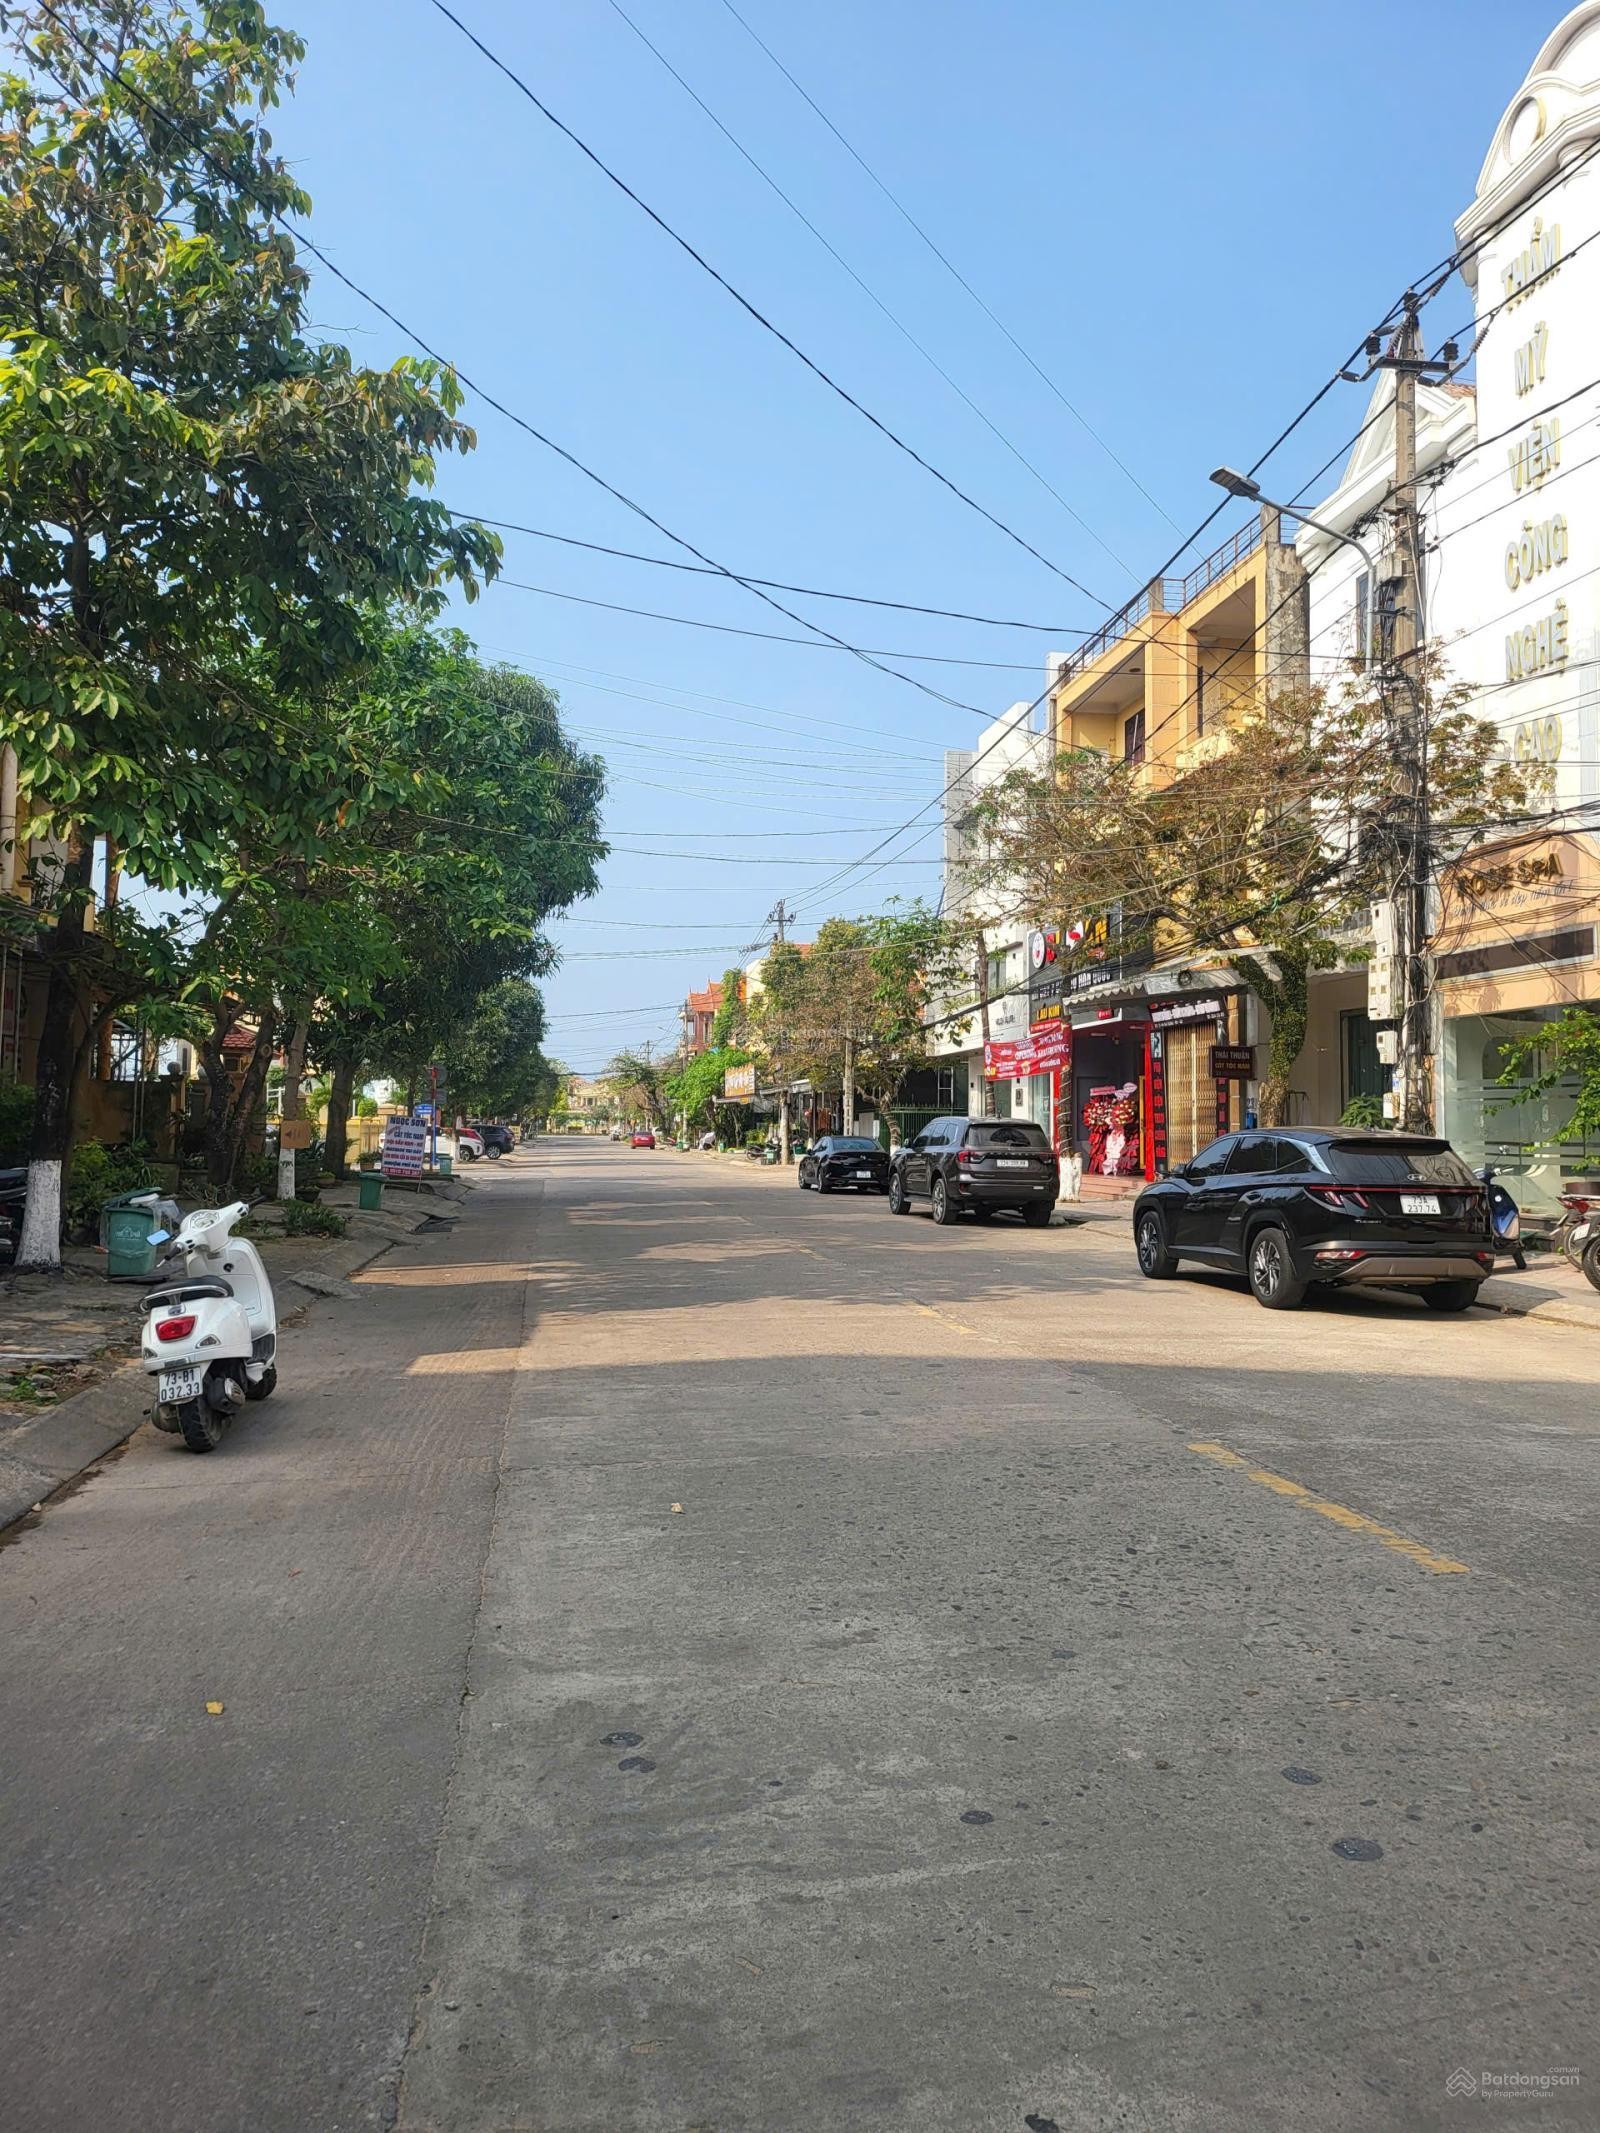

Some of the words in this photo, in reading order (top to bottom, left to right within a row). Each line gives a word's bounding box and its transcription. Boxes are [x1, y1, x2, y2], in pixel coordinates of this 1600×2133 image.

[1513, 320, 1549, 399] MỸ
[1507, 418, 1560, 494] VIỆN
[1504, 513, 1568, 592] CÔNG
[1505, 598, 1568, 682] NGHỆ
[1513, 713, 1562, 766] CAO
[1517, 853, 1564, 884] SPA
[161, 1382, 200, 1401] 032.33
[165, 1369, 195, 1387] 73-B1
